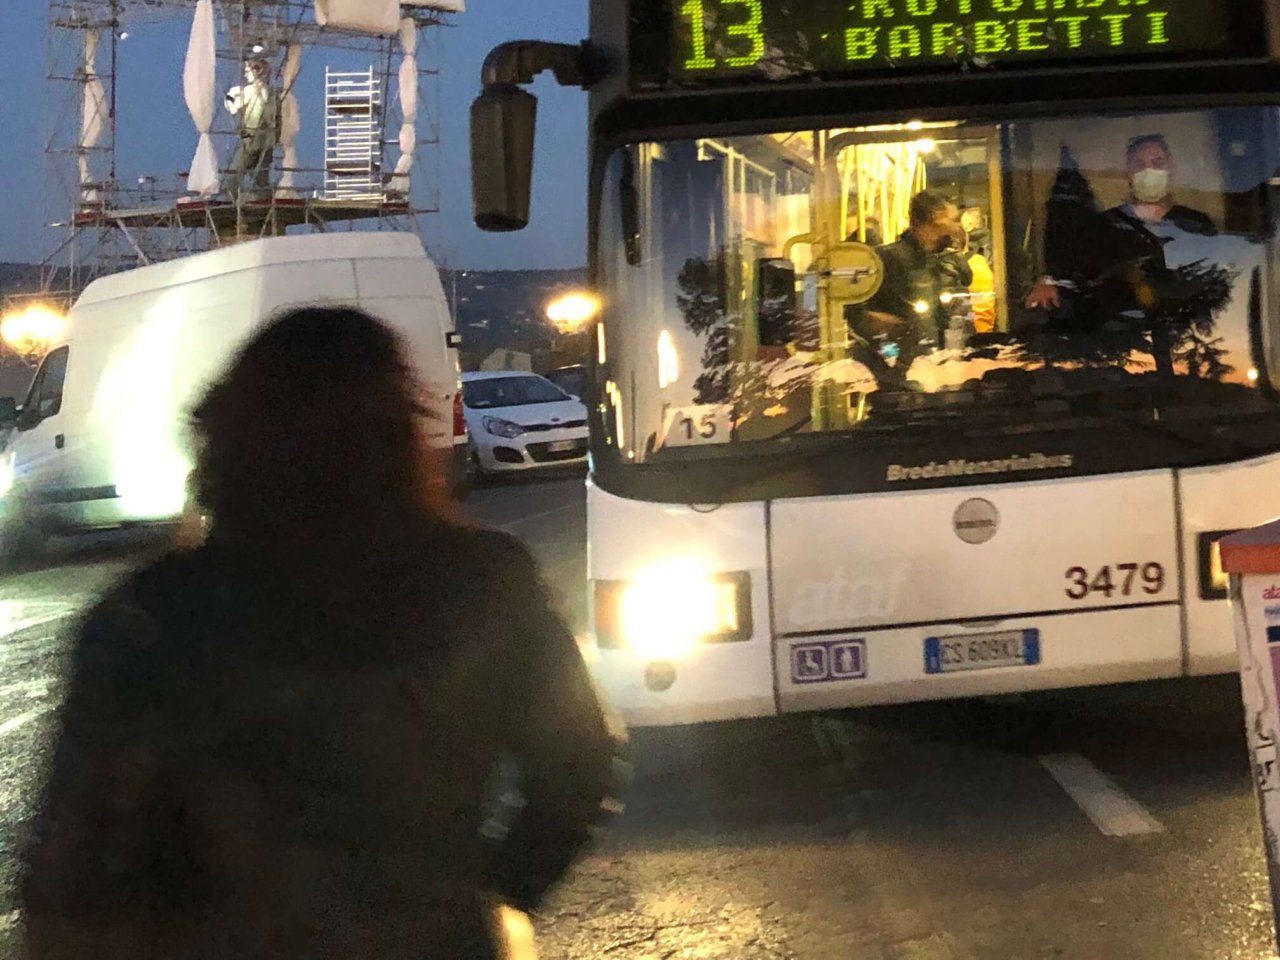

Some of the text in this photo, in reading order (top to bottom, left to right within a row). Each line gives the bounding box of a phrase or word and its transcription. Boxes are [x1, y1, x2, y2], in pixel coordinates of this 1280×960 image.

[845, 12, 1169, 60] BARBETTI
[680, 414, 716, 439] 15
[1064, 561, 1165, 600] 3479
